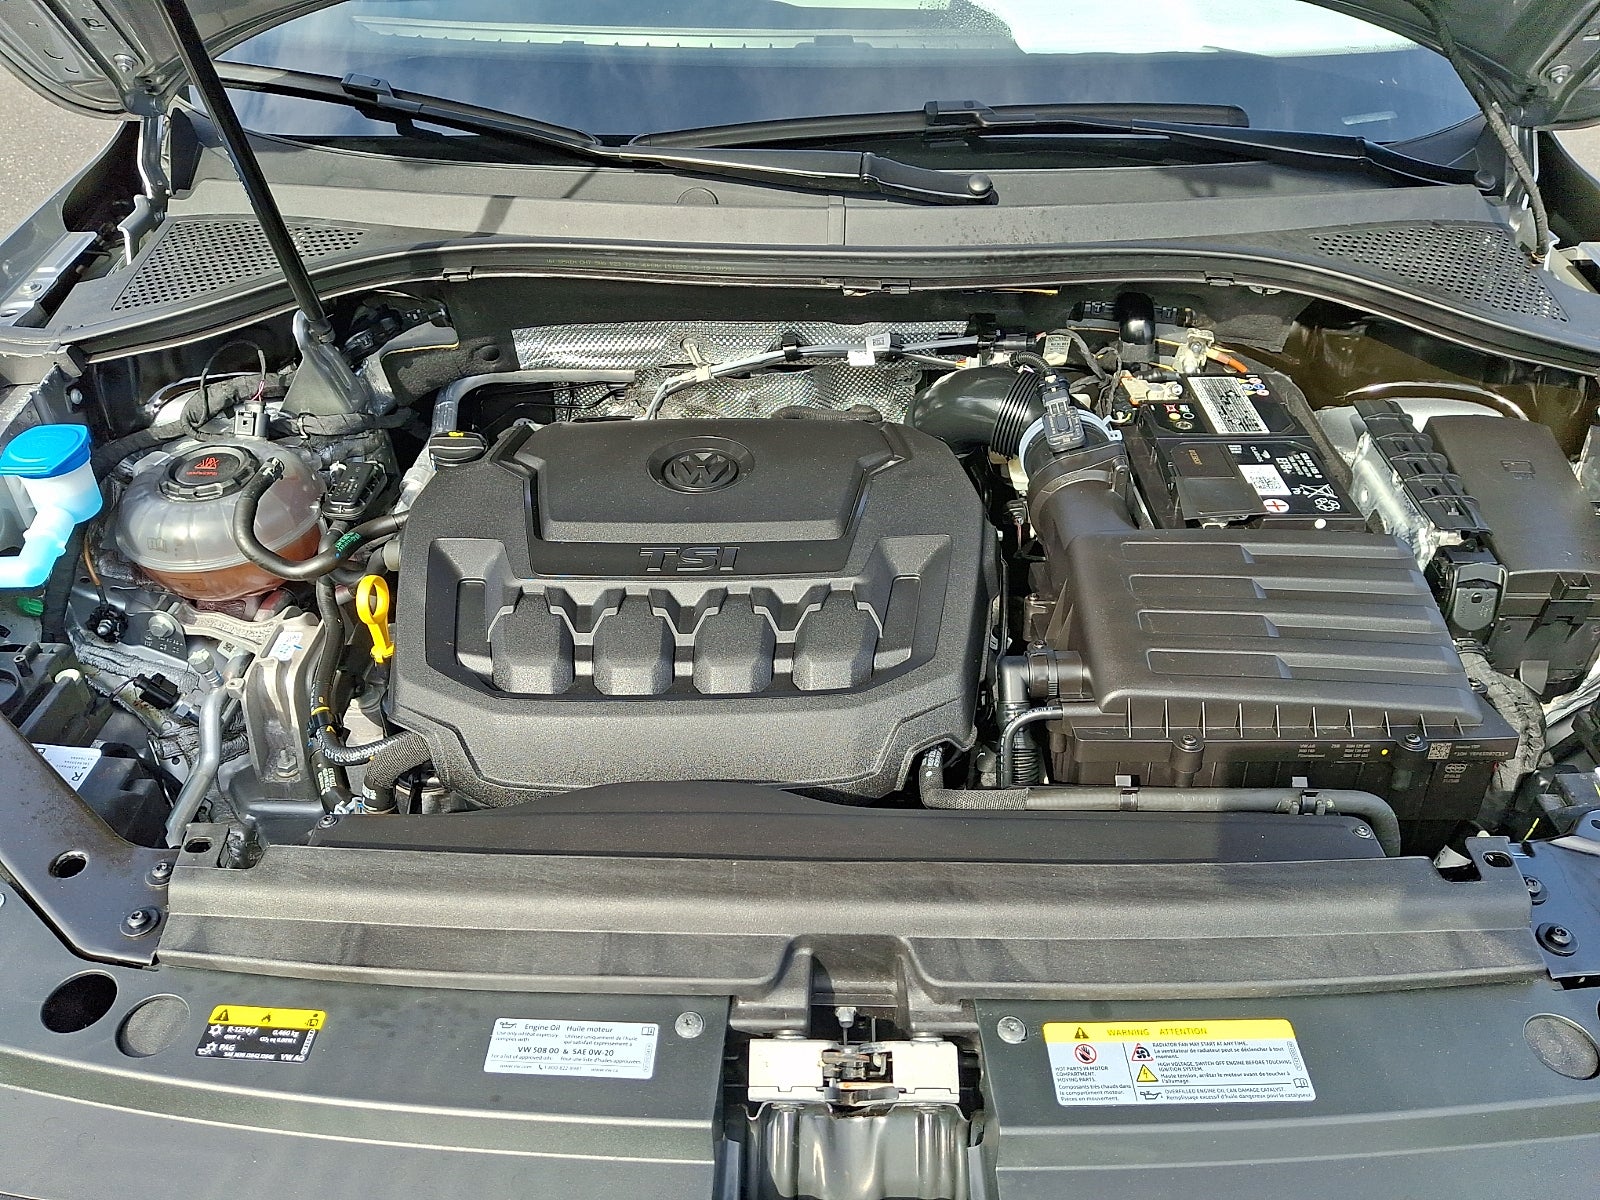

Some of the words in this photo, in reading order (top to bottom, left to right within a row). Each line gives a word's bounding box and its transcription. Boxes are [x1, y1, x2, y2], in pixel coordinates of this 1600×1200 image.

[639, 546, 740, 572] TSI
[226, 1026, 258, 1036] R-1234yf
[524, 1024, 549, 1032] Engine
[1106, 1028, 1150, 1037] WARNING
[1159, 1027, 1208, 1036] ATTENTION
